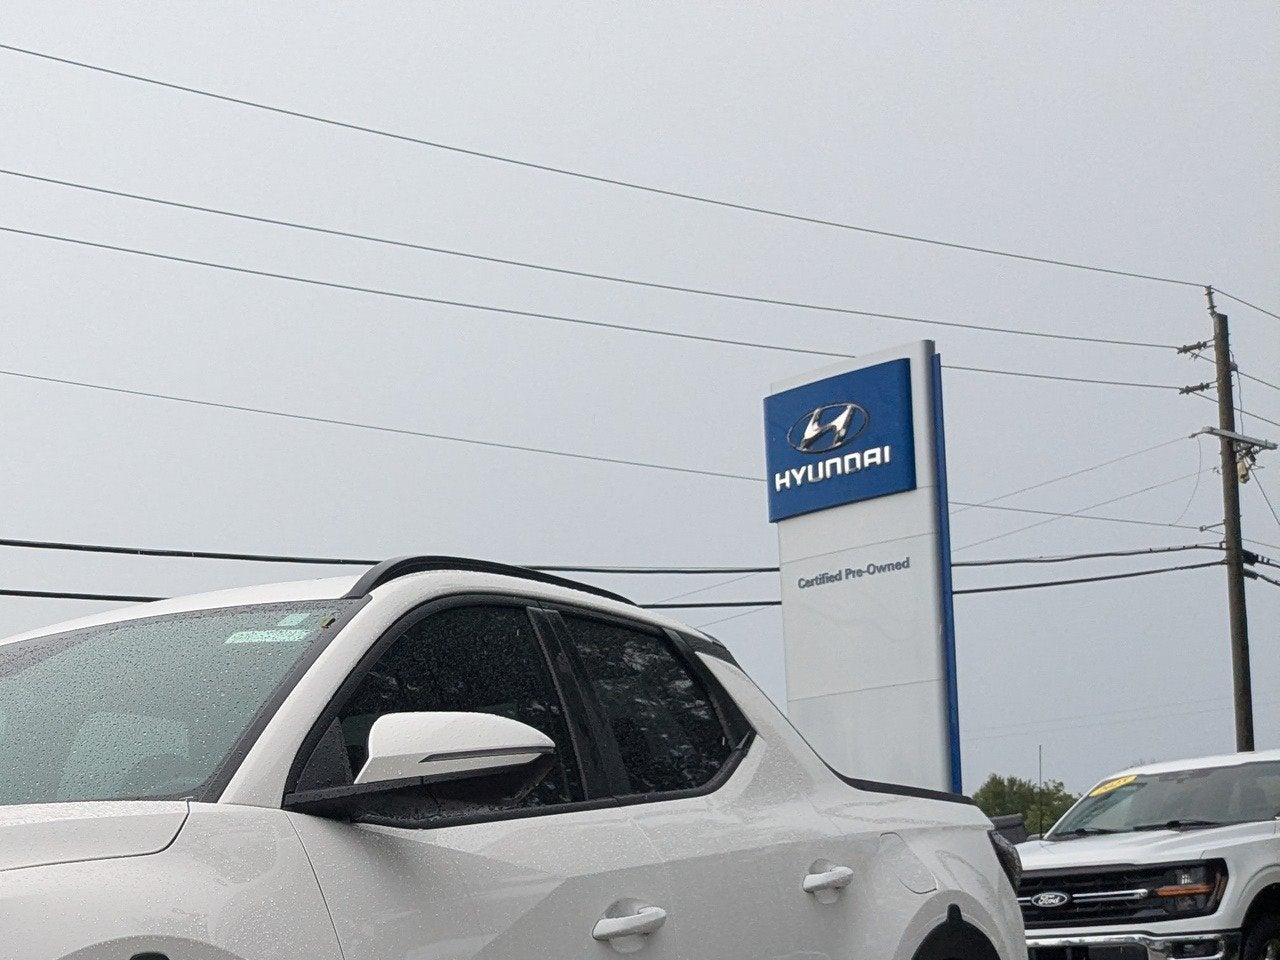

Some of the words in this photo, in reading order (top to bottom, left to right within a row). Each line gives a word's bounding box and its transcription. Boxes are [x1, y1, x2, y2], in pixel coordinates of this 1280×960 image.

[775, 445, 891, 491] HYUNDAI
[798, 570, 842, 588] Certified
[845, 557, 910, 579] Pre-Owned
